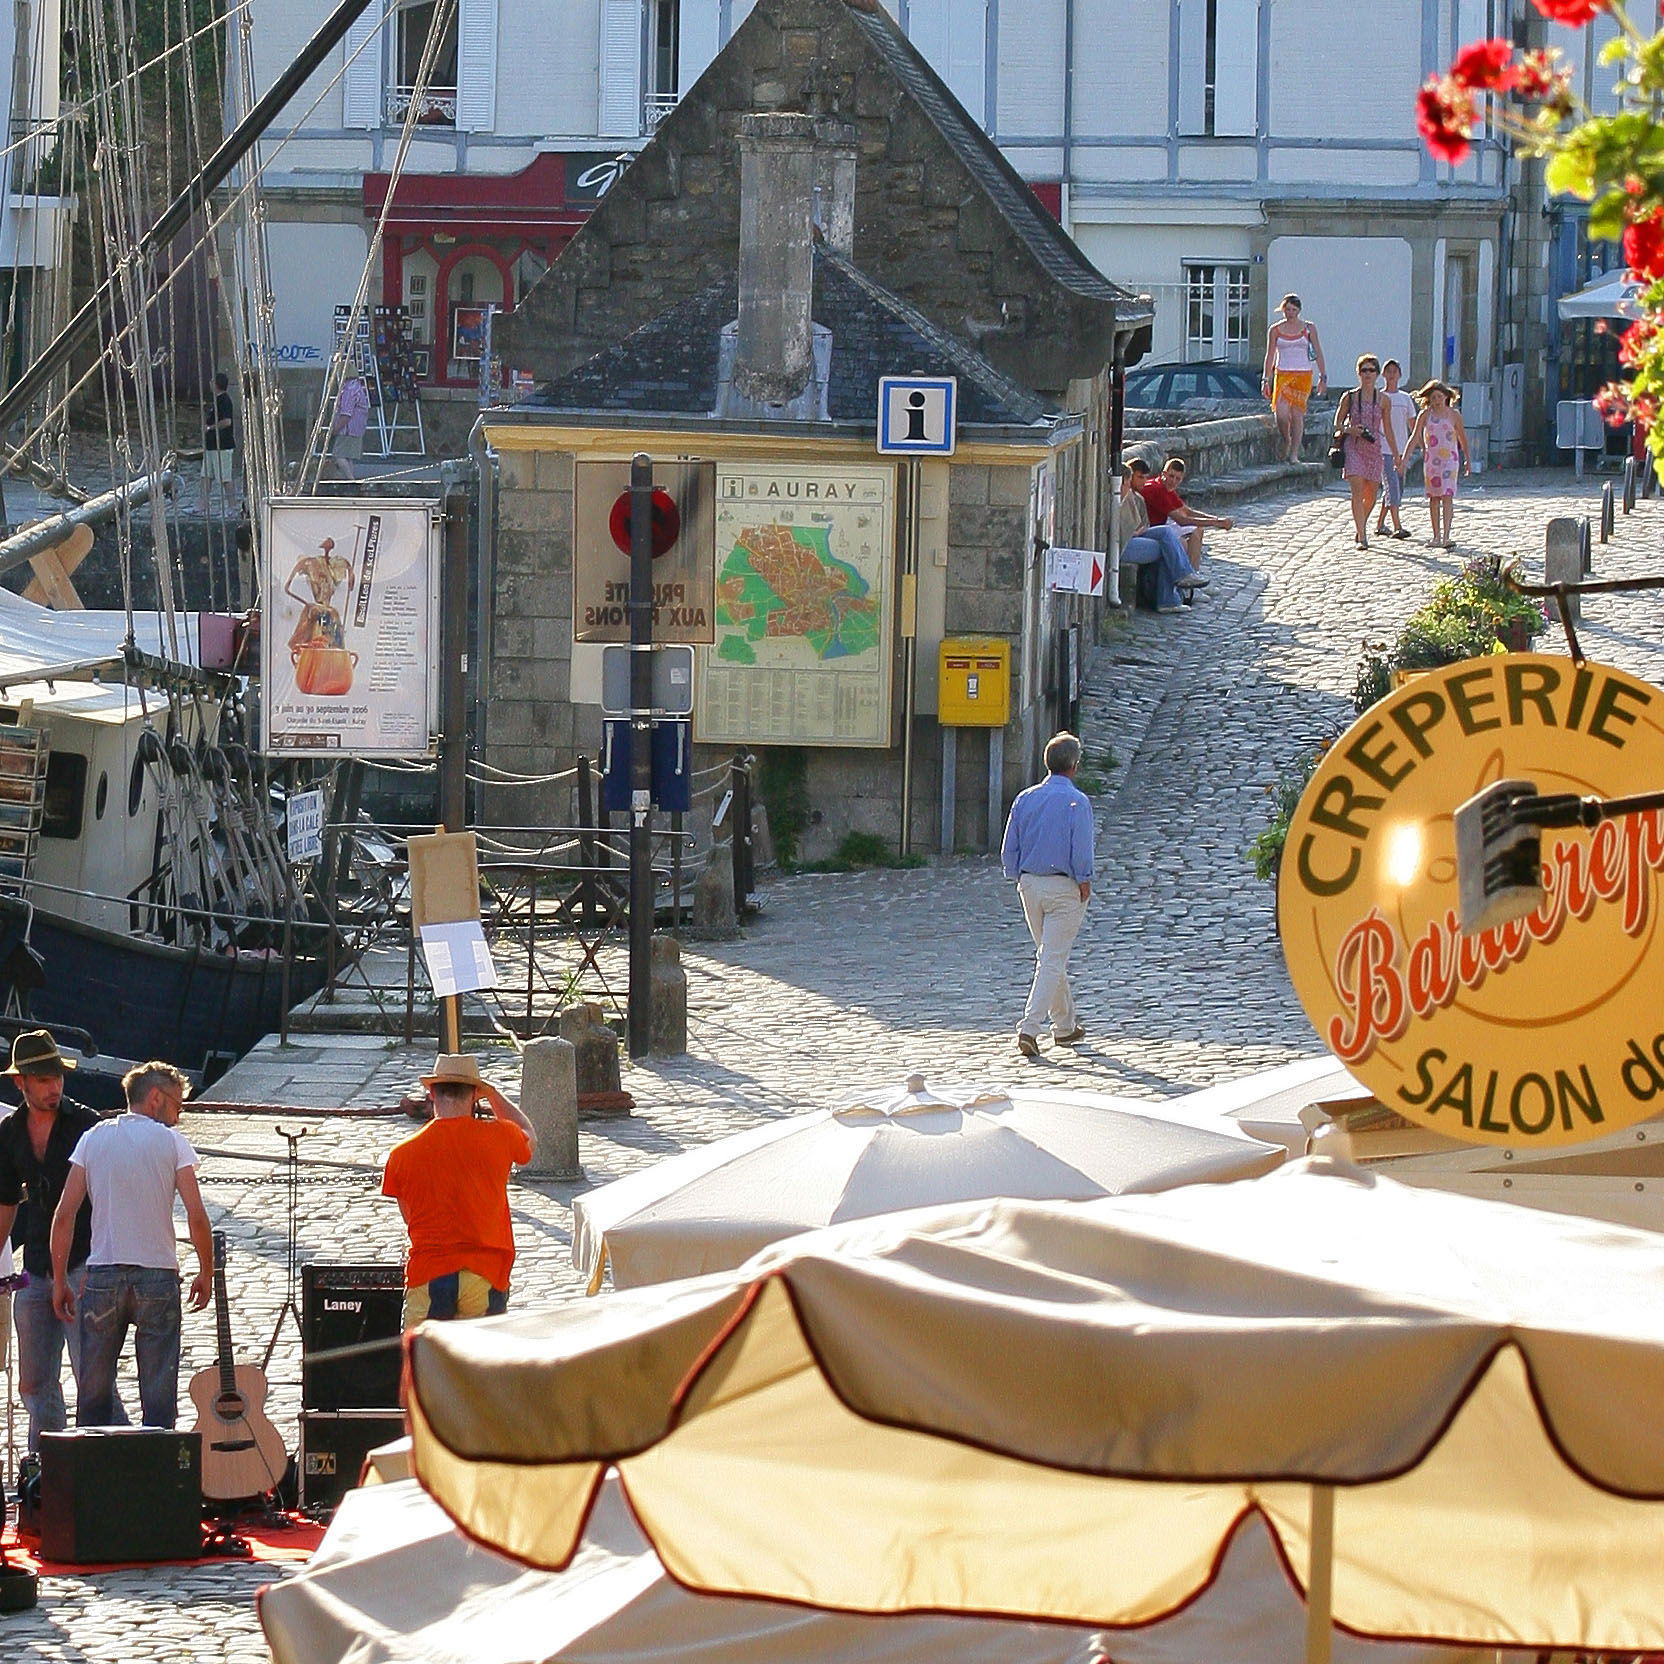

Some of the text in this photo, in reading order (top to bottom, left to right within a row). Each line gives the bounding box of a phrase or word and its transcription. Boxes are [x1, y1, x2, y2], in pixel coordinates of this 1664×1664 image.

[767, 481, 857, 499] AURAY
[1298, 663, 1652, 897] CREPERIE
[1397, 1047, 1605, 1135] SALON
[323, 1298, 363, 1313] Laney
